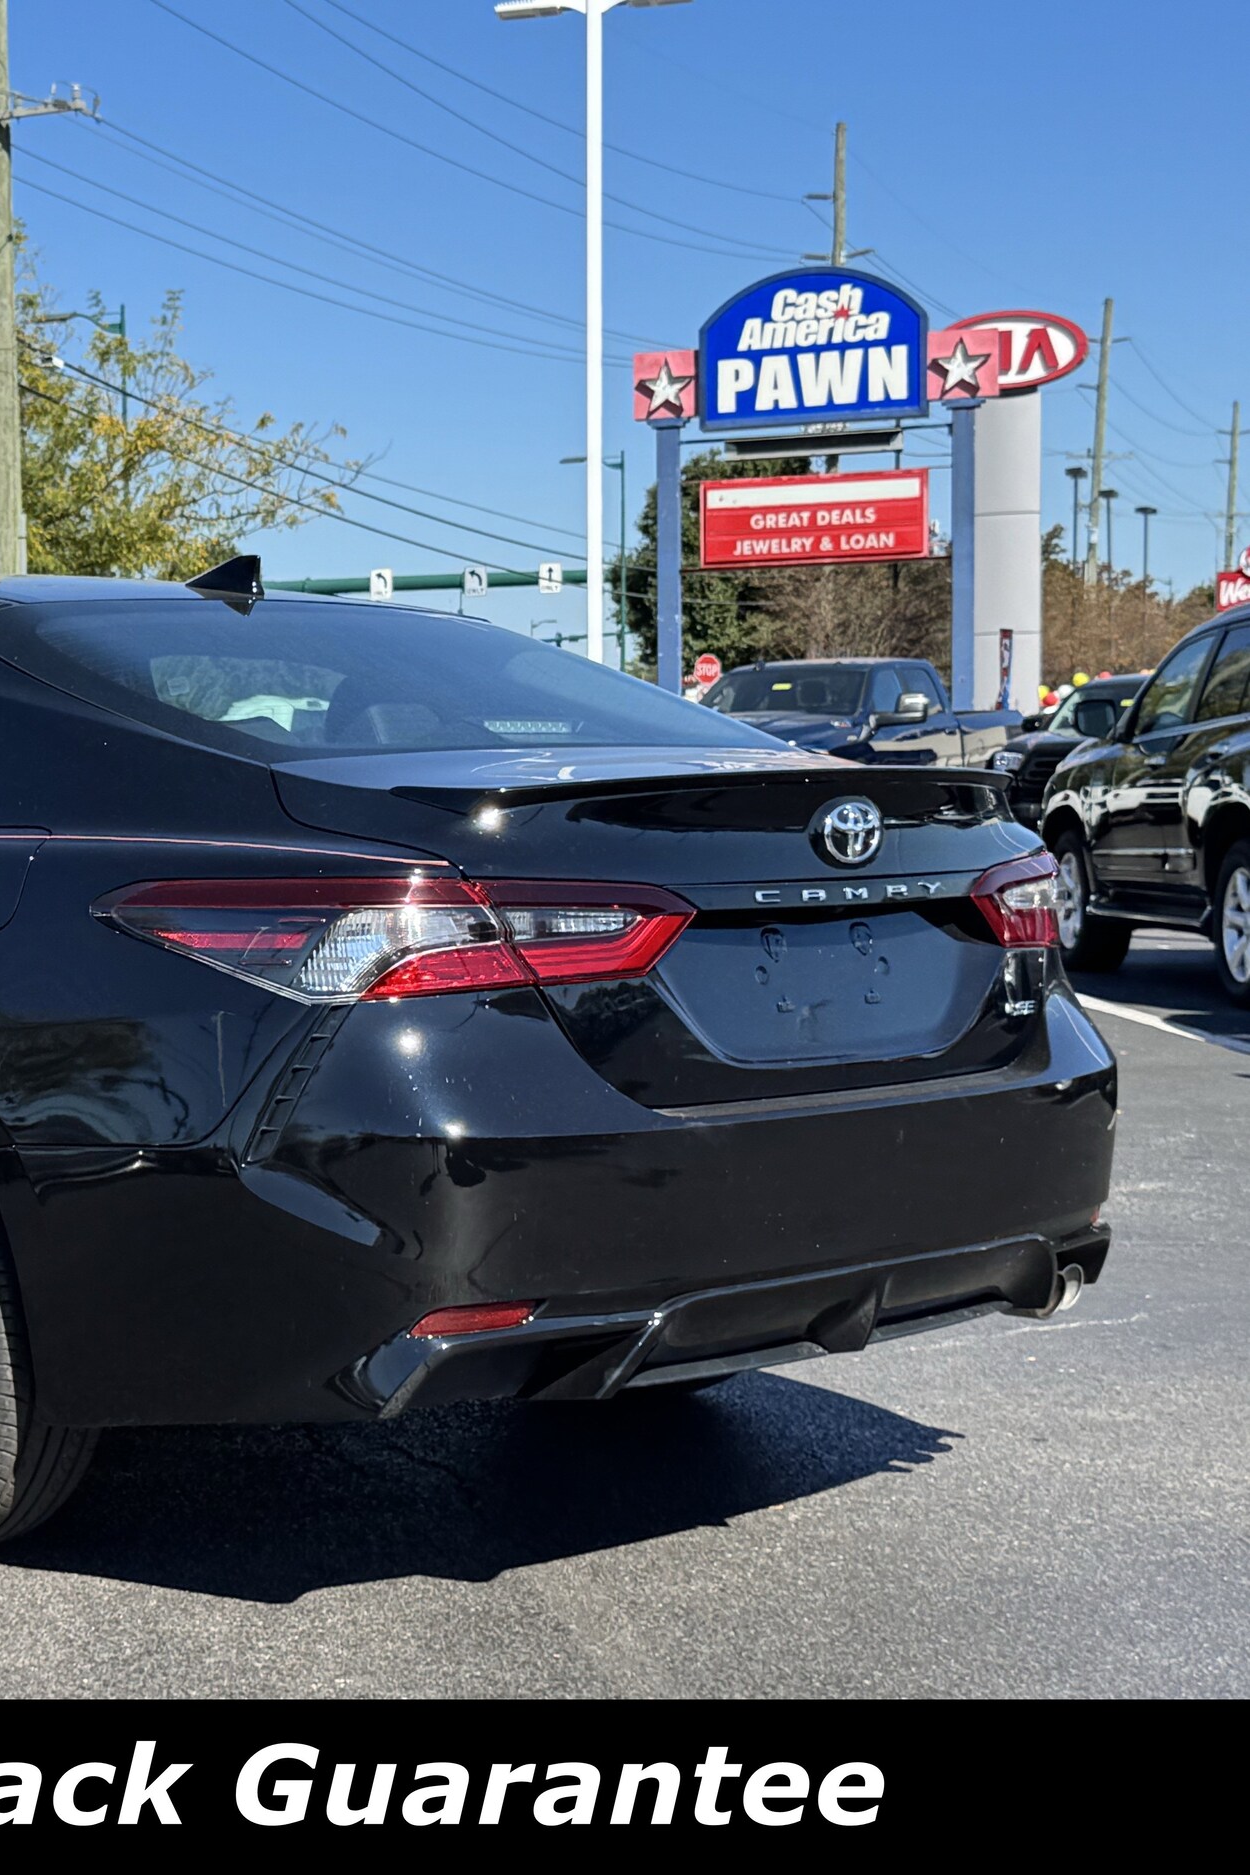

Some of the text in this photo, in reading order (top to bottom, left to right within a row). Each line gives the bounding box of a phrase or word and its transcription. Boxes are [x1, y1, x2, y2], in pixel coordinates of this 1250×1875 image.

[771, 283, 863, 322] Cash
[737, 311, 891, 351] America
[998, 327, 1060, 376] IA
[717, 344, 909, 414] PAWN
[750, 507, 877, 530] GREAT DEALS
[733, 532, 895, 556] JEWELRY & LOAN
[696, 663, 718, 677] STOP
[754, 881, 943, 903] CAMRY
